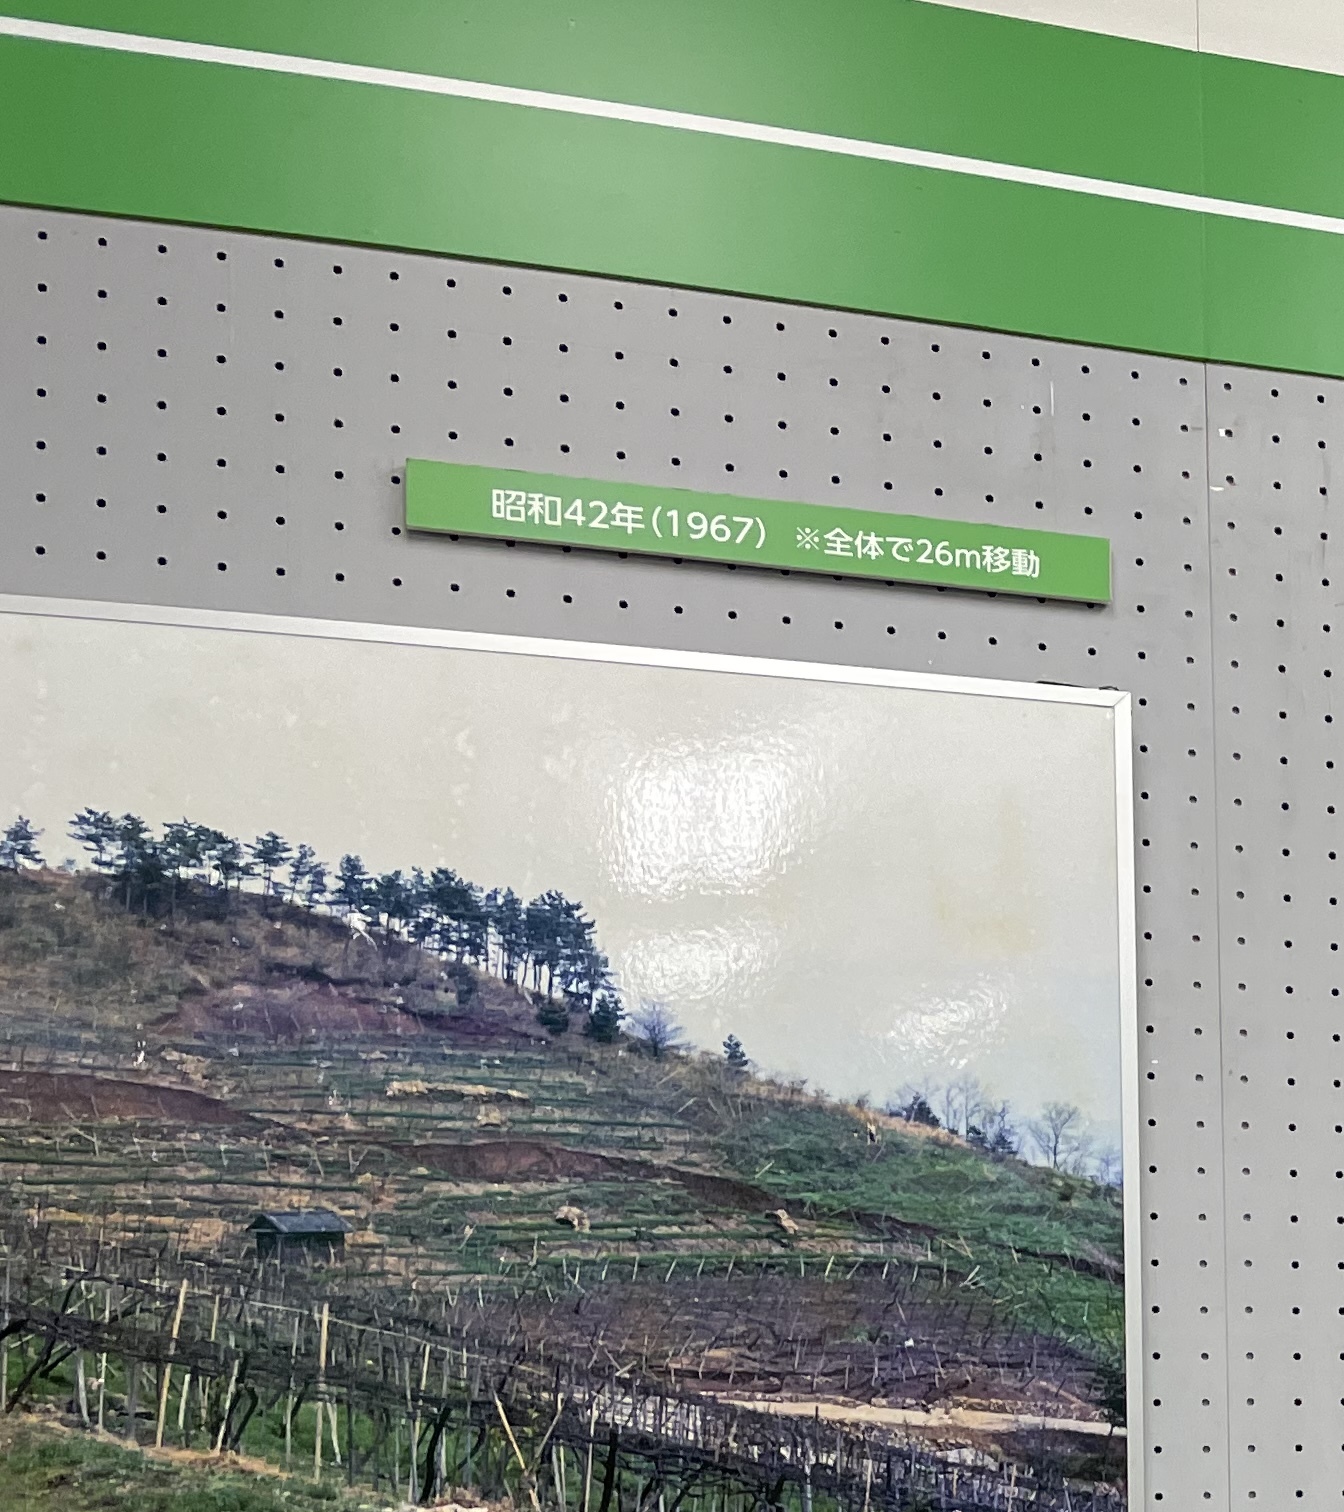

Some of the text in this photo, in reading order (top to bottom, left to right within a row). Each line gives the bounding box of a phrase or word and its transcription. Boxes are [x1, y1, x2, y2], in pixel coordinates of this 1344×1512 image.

[795, 525, 1040, 579] ※全体で26m移動
